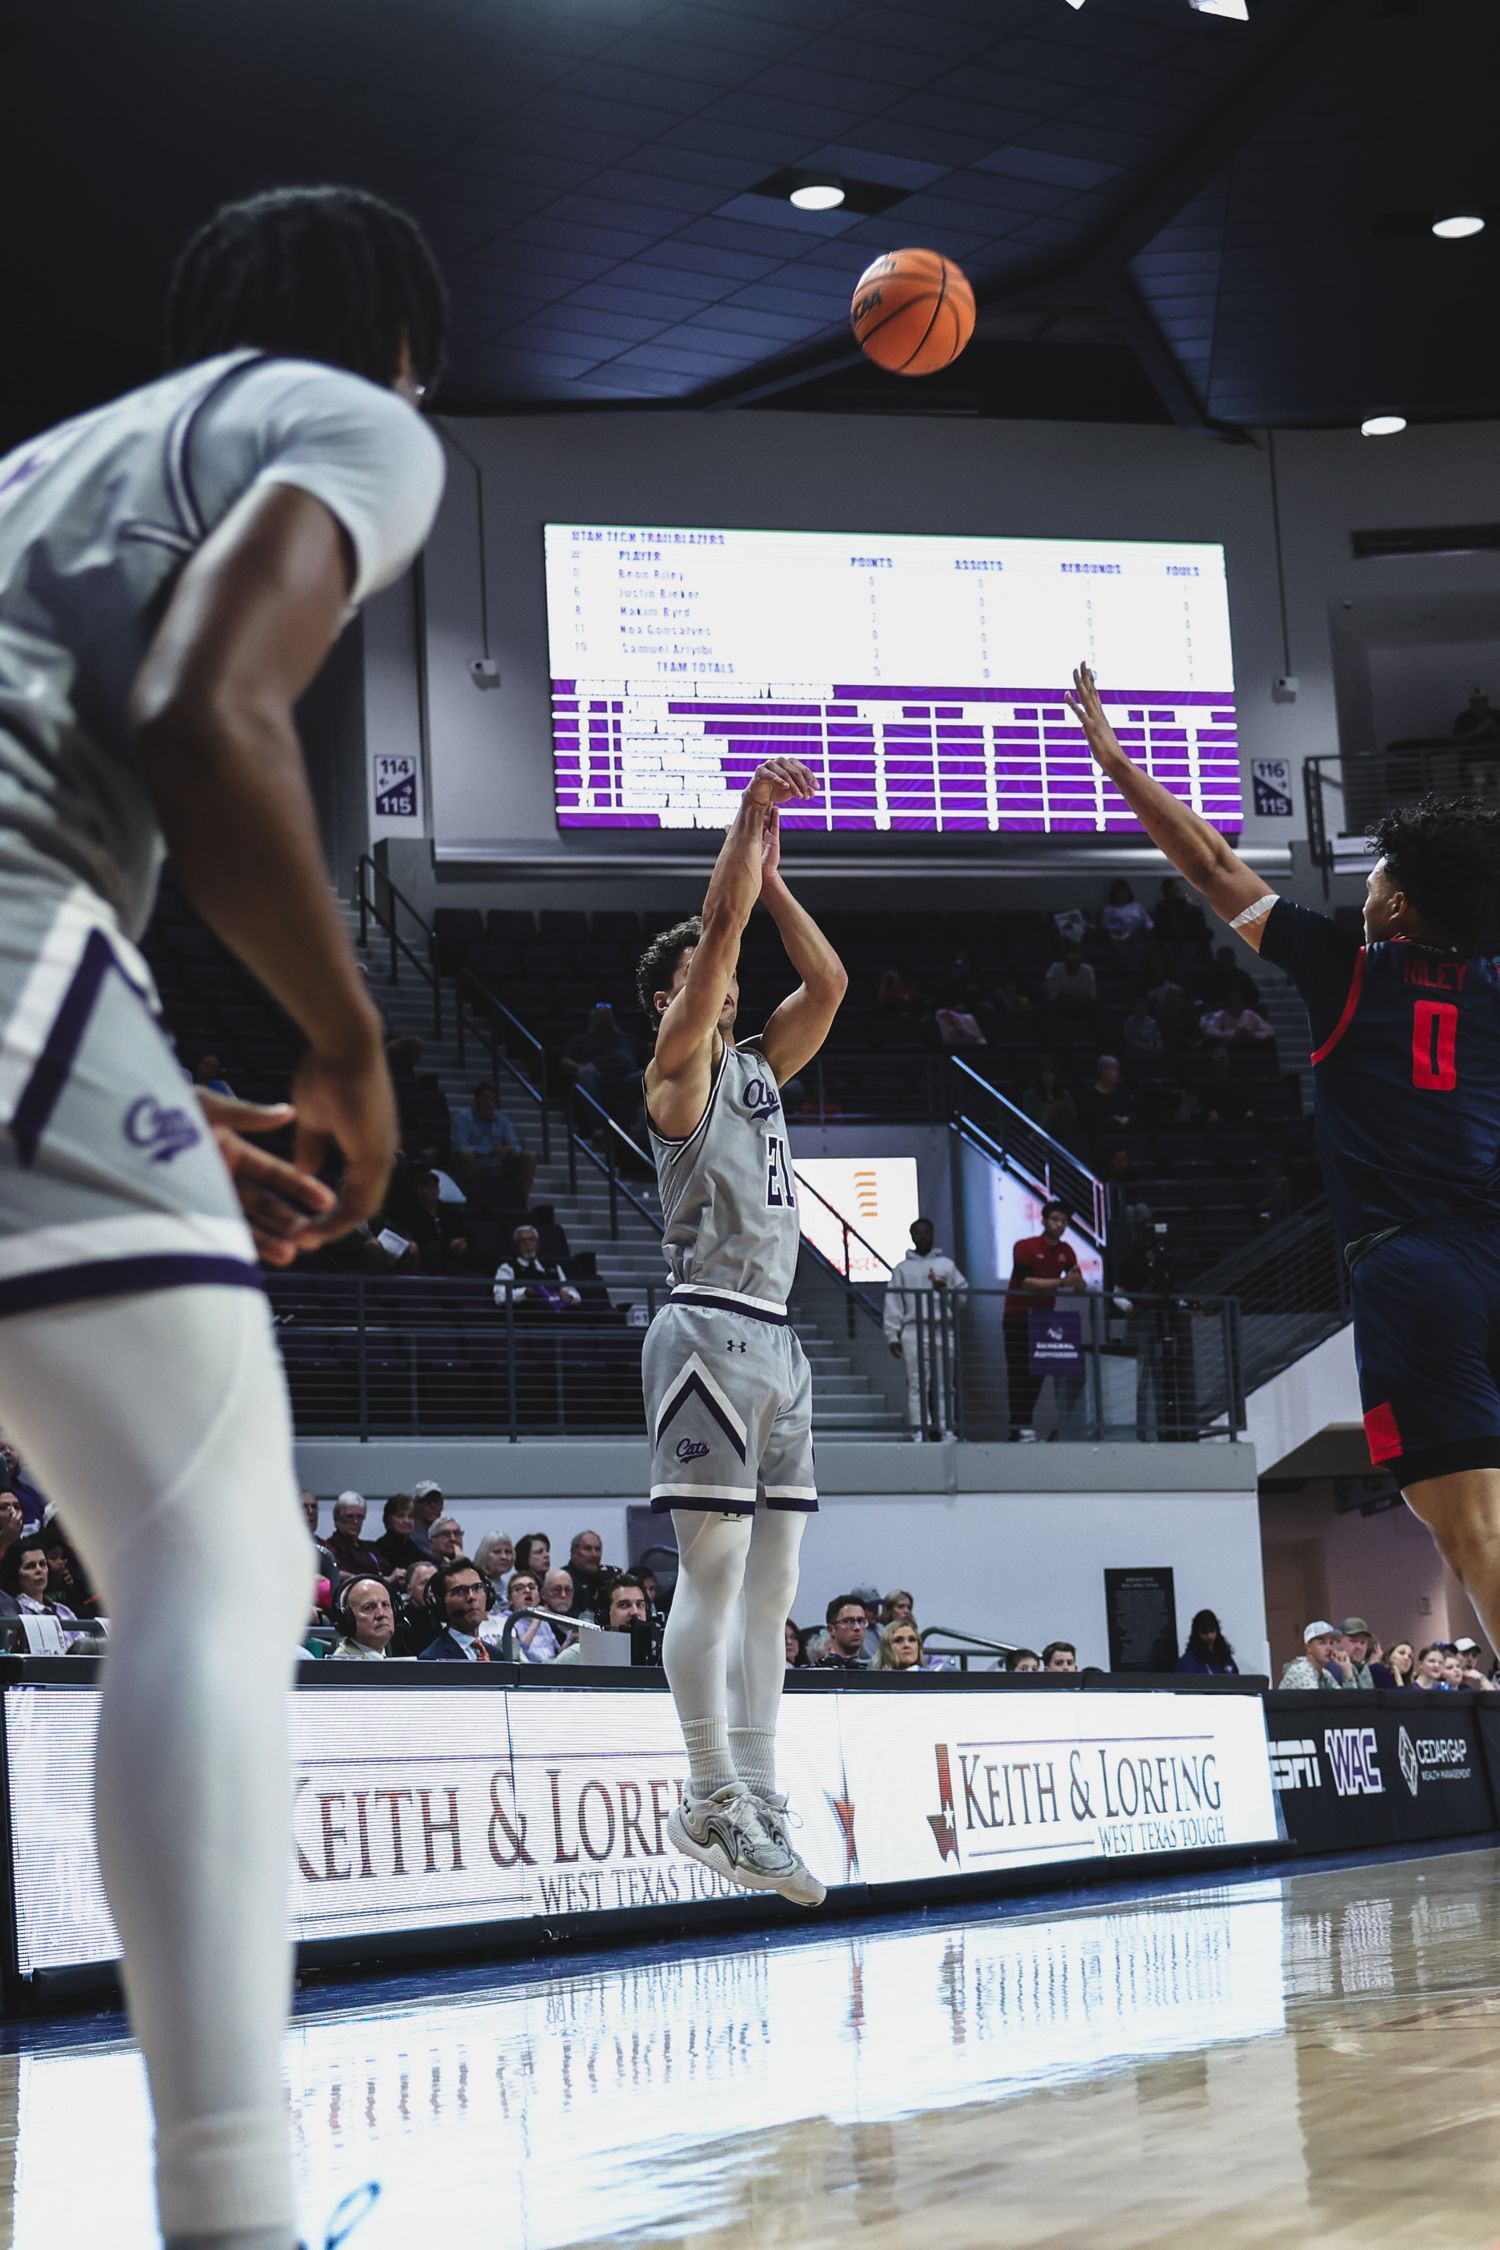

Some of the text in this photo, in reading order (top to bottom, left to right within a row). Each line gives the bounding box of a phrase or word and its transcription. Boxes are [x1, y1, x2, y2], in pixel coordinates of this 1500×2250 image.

[381, 759, 409, 775] 114
[1258, 762, 1285, 778] 116
[381, 796, 412, 814] 115
[1260, 798, 1288, 814] 115
[1403, 959, 1469, 991] RILEY
[1412, 1000, 1459, 1091] 0
[765, 1133, 796, 1210] 21
[676, 1438, 710, 1463] Cats
[1324, 1727, 1384, 1796] WAC
[959, 1749, 1222, 1830] KEITH & LORFING
[487, 1769, 540, 1869] &
[546, 1768, 685, 1864] LORF
[1098, 1816, 1227, 1854] WEST TEXAS TOUGH
[538, 1872, 604, 1915] WEST
[611, 1865, 680, 1909] TEXAS
